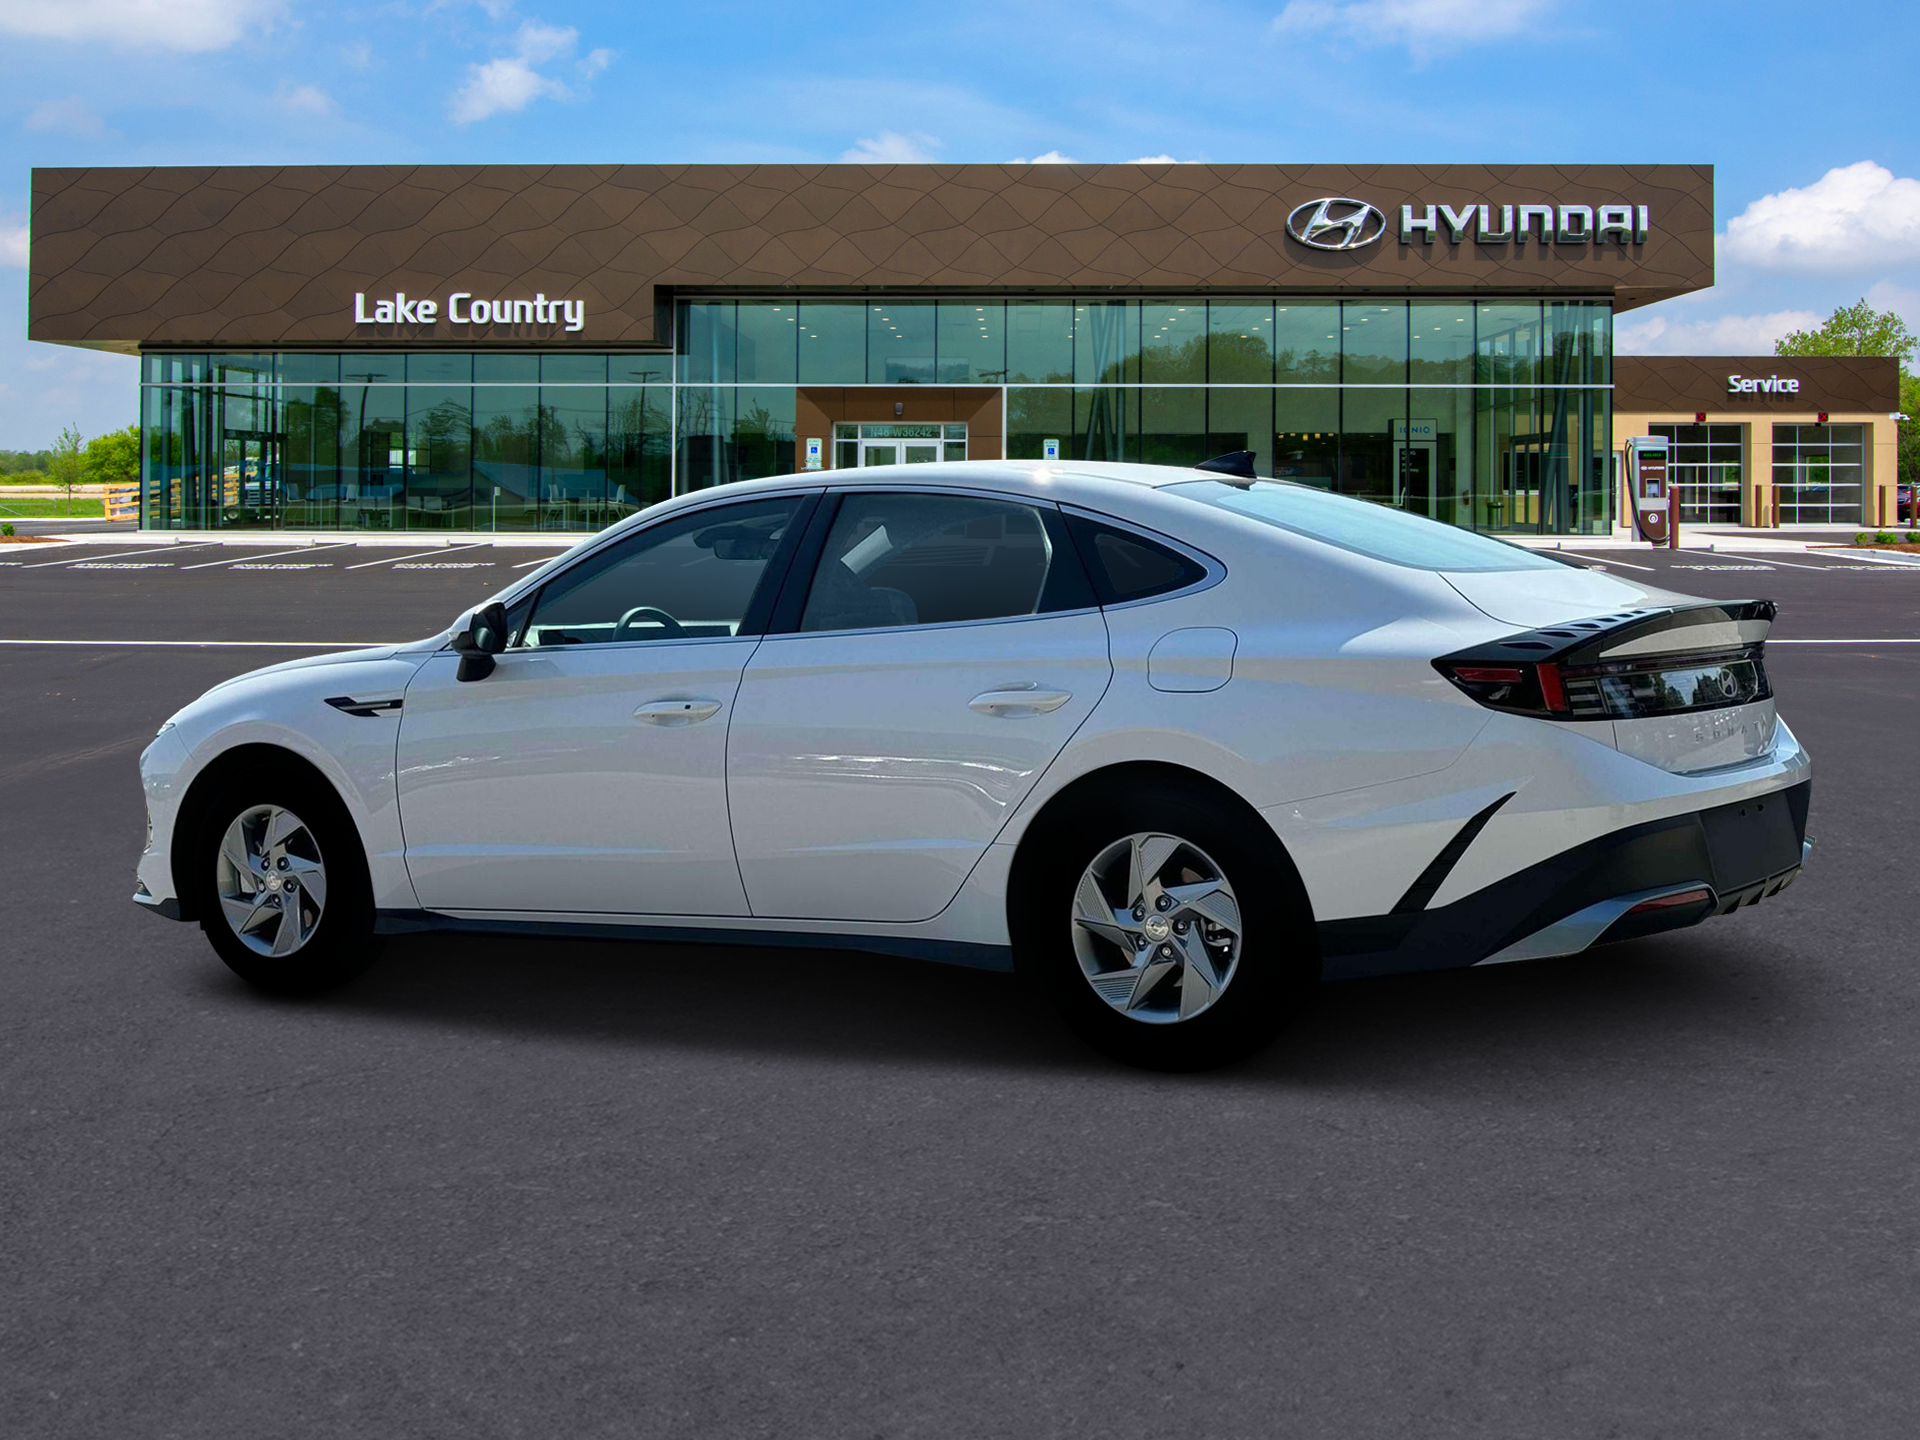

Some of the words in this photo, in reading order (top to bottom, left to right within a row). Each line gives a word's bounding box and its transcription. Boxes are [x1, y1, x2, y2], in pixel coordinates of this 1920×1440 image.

[1400, 204, 1649, 244] HYUNDAI
[355, 292, 438, 324] Lake
[449, 292, 585, 332] Country
[1727, 374, 1800, 393] Service
[870, 426, 890, 437] N48
[893, 426, 932, 437] W36242
